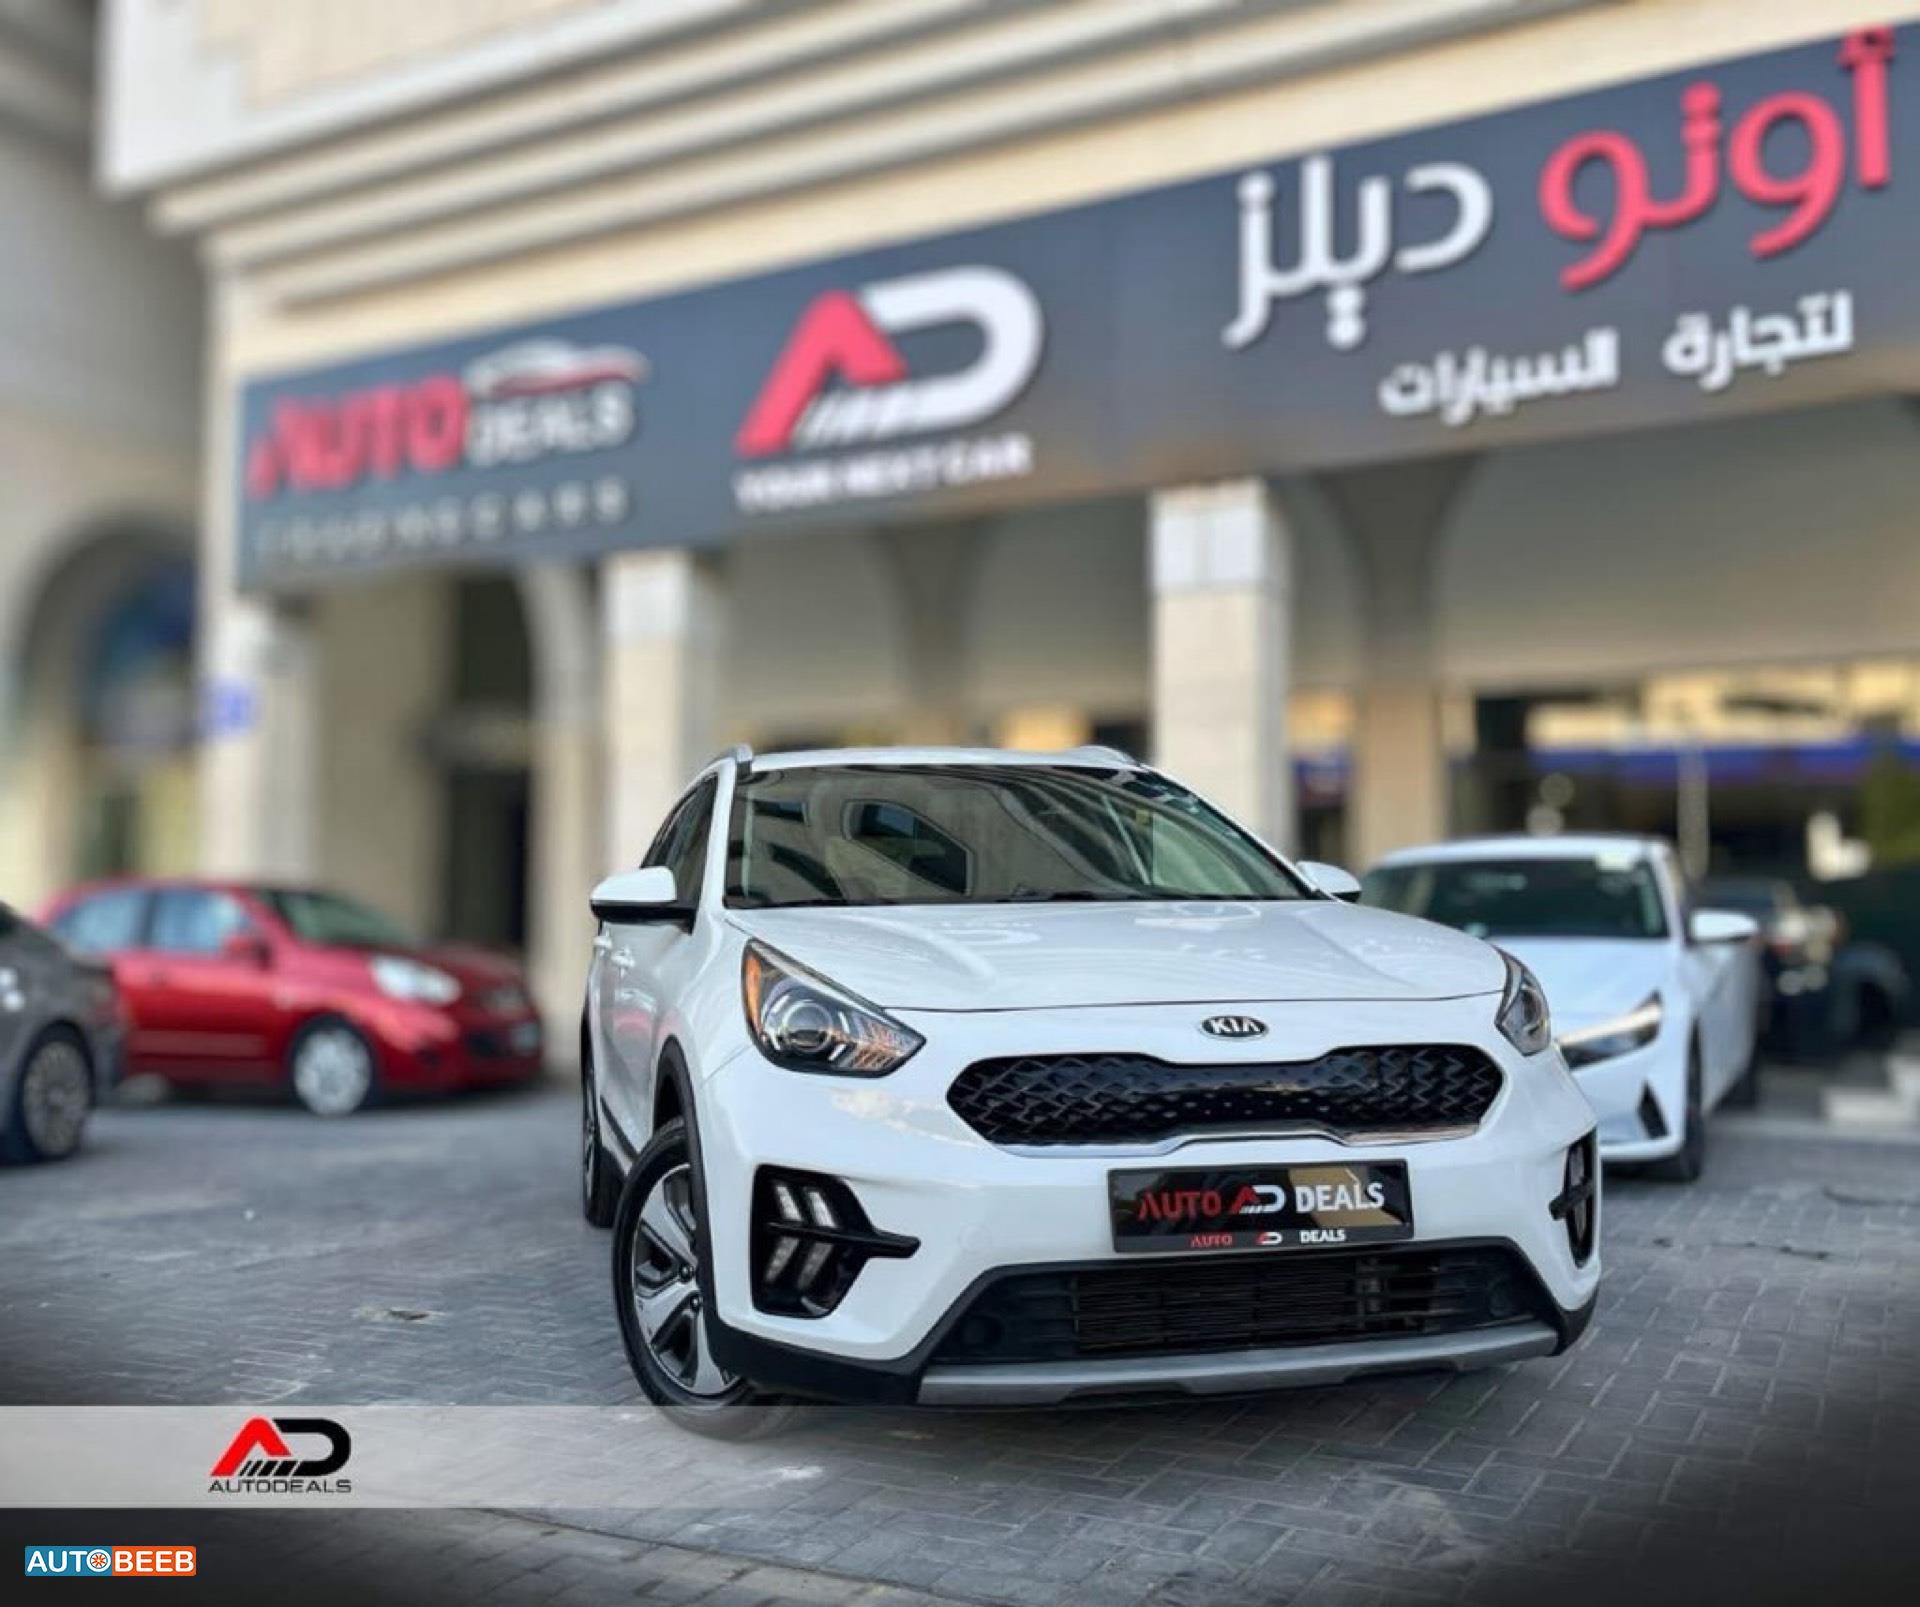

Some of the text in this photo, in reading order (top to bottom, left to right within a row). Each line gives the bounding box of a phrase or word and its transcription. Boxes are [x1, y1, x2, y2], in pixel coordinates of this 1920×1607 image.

[1222, 25, 1896, 350] أوتو ديلز
[1378, 289, 1855, 427] لتجارة السيارات
[247, 372, 469, 500] AUTO
[1210, 1017, 1260, 1033] KIA
[1138, 1189, 1222, 1222] AUTO
[1294, 1182, 1385, 1214] DEALS
[1191, 1233, 1233, 1248] AUTO
[1299, 1229, 1346, 1244] DEALS
